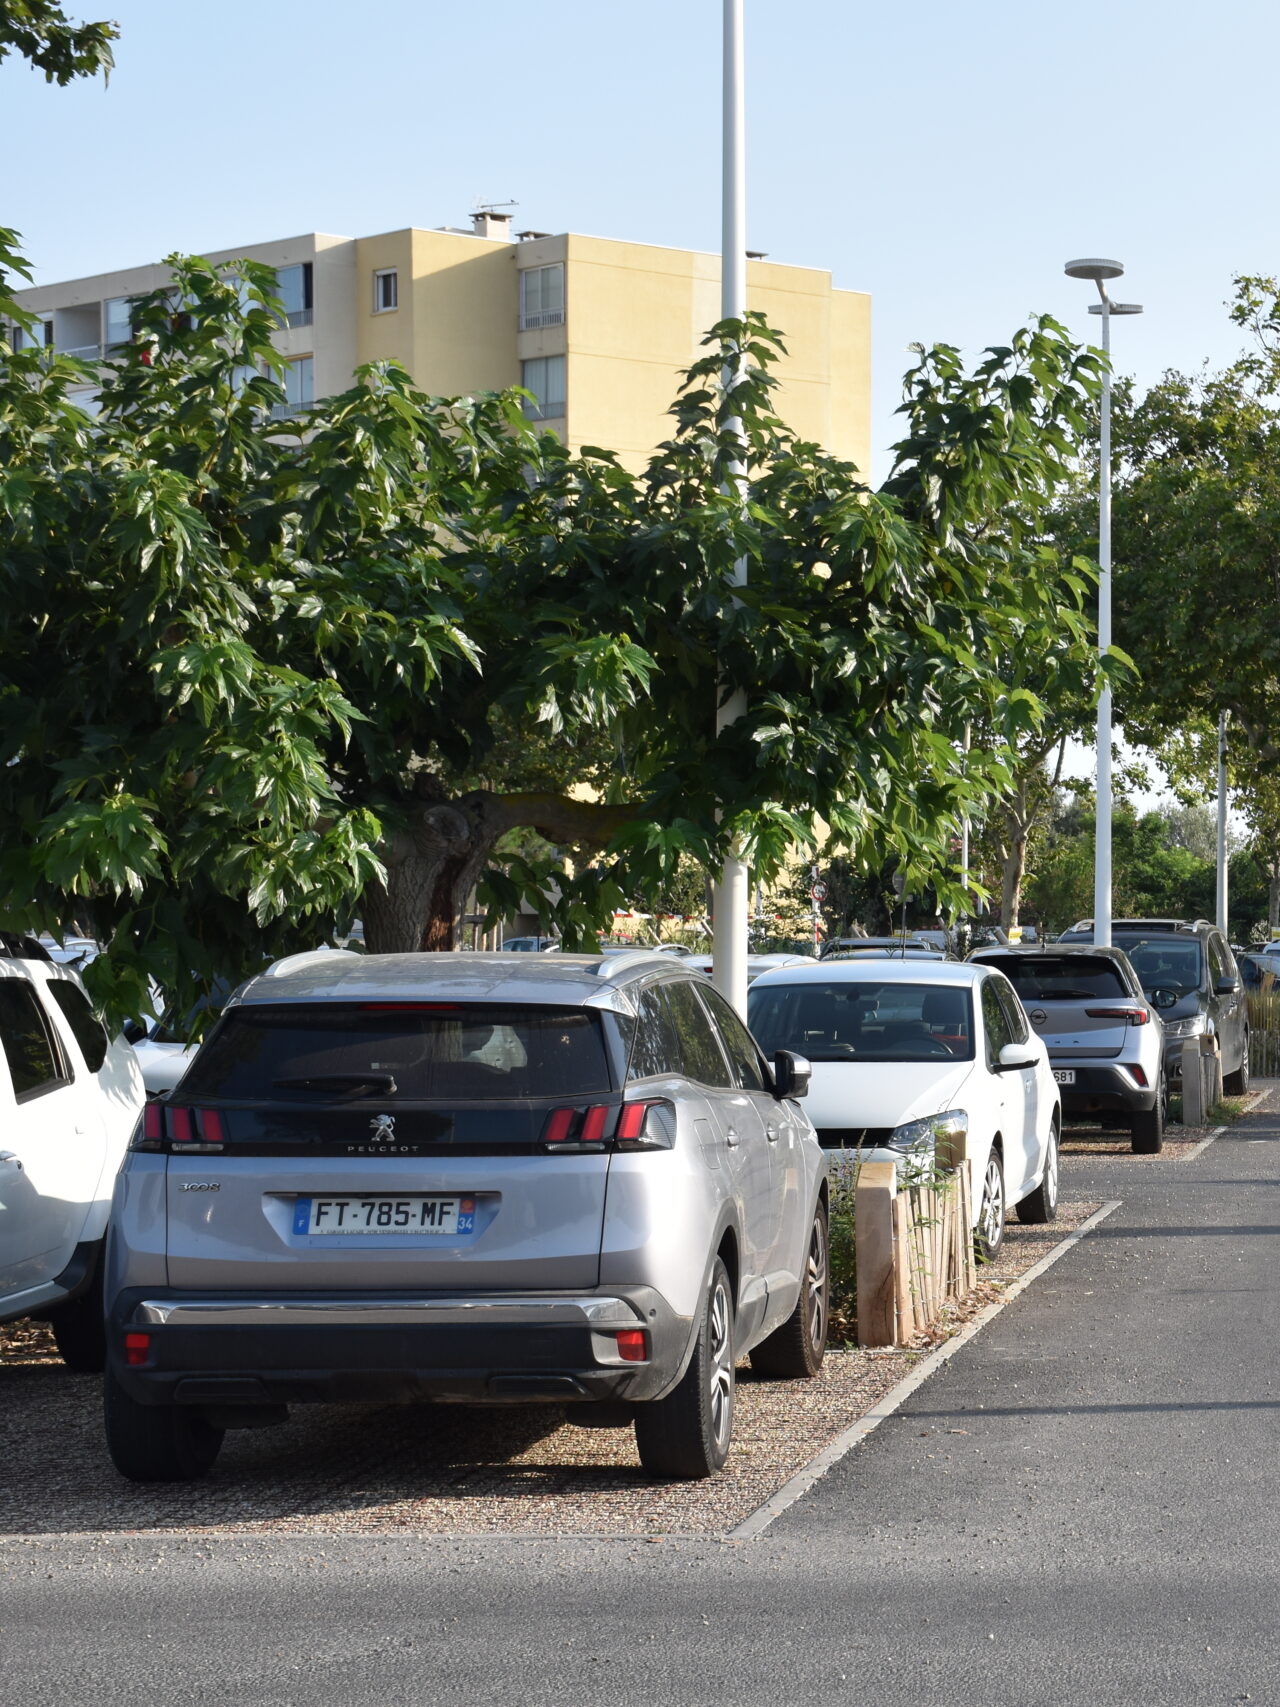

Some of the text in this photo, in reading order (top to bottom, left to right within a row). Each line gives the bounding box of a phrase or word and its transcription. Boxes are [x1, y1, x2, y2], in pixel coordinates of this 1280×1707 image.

[178, 1182, 221, 1193] 3008
[316, 1202, 454, 1226] FT-785-MF
[298, 1219, 305, 1228] F
[458, 1217, 472, 1230] 34
